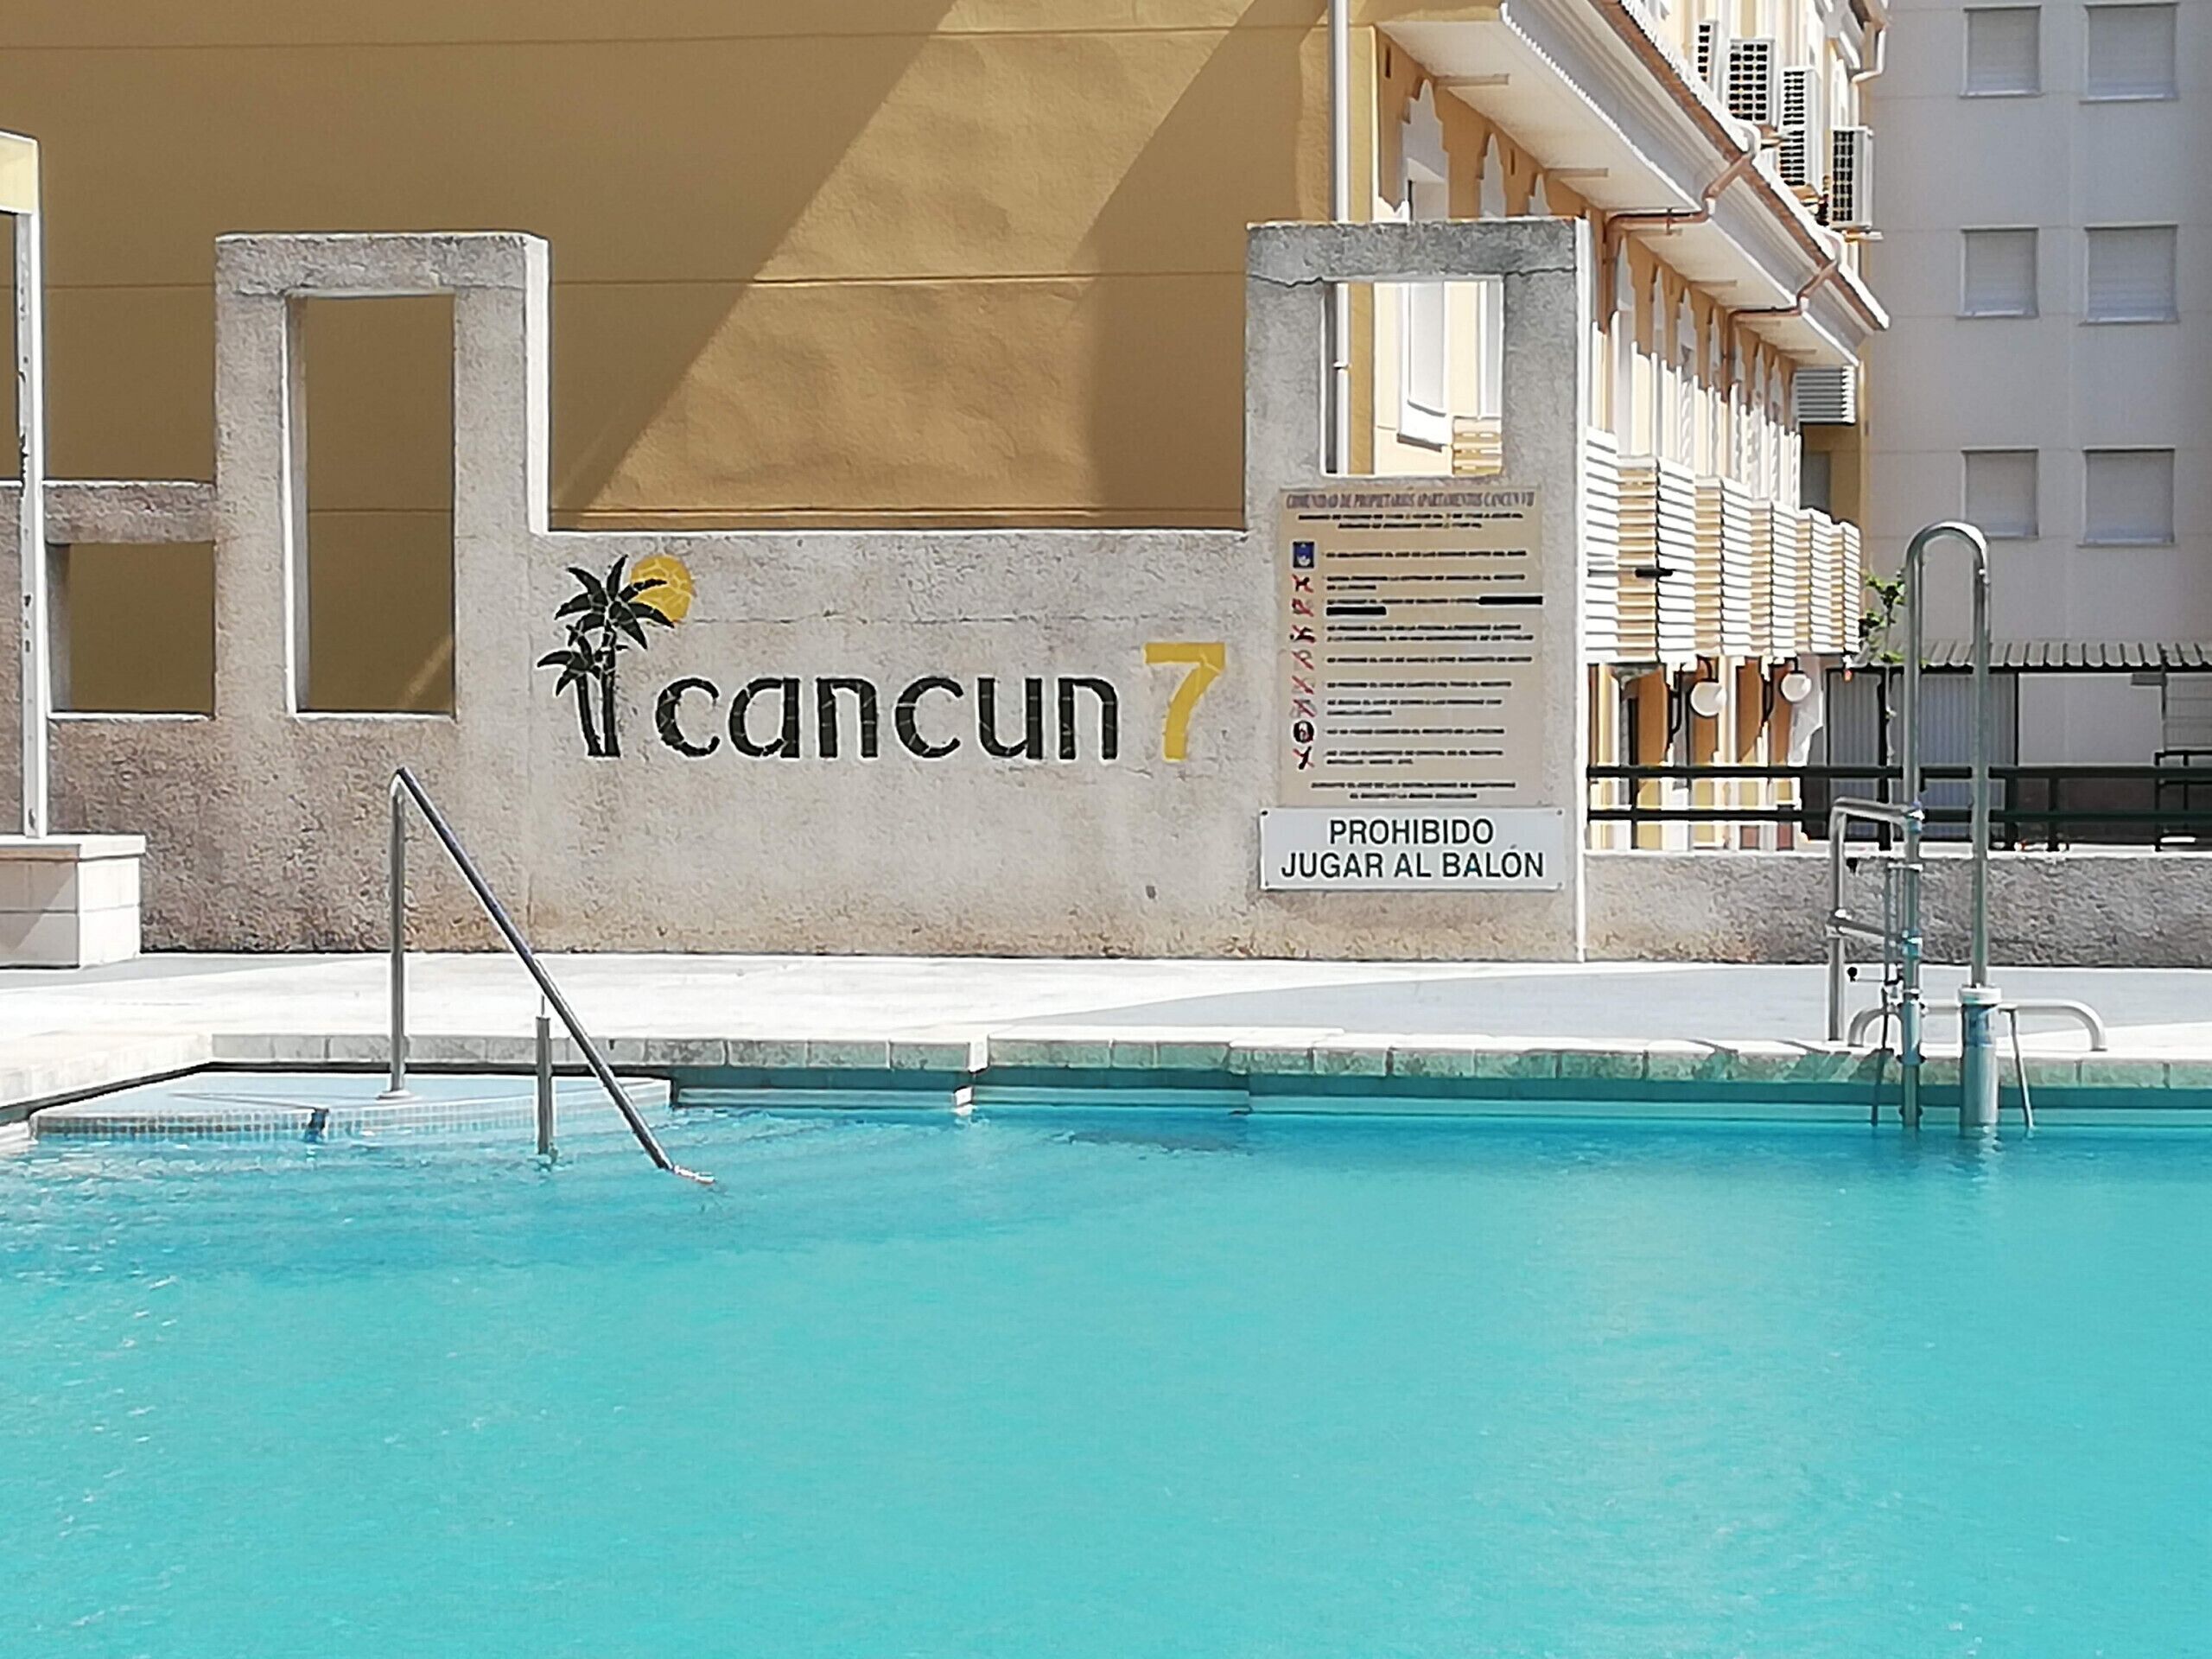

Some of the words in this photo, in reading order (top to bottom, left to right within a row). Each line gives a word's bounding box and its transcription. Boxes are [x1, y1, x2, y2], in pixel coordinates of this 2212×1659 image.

[655, 677, 1118, 760] cancun
[1146, 642, 1225, 760] 7
[1329, 818, 1494, 845] PROHIBIDO
[1281, 852, 1383, 878] JUGAR
[1394, 852, 1432, 878] AL
[1442, 843, 1543, 878] BALÓN
